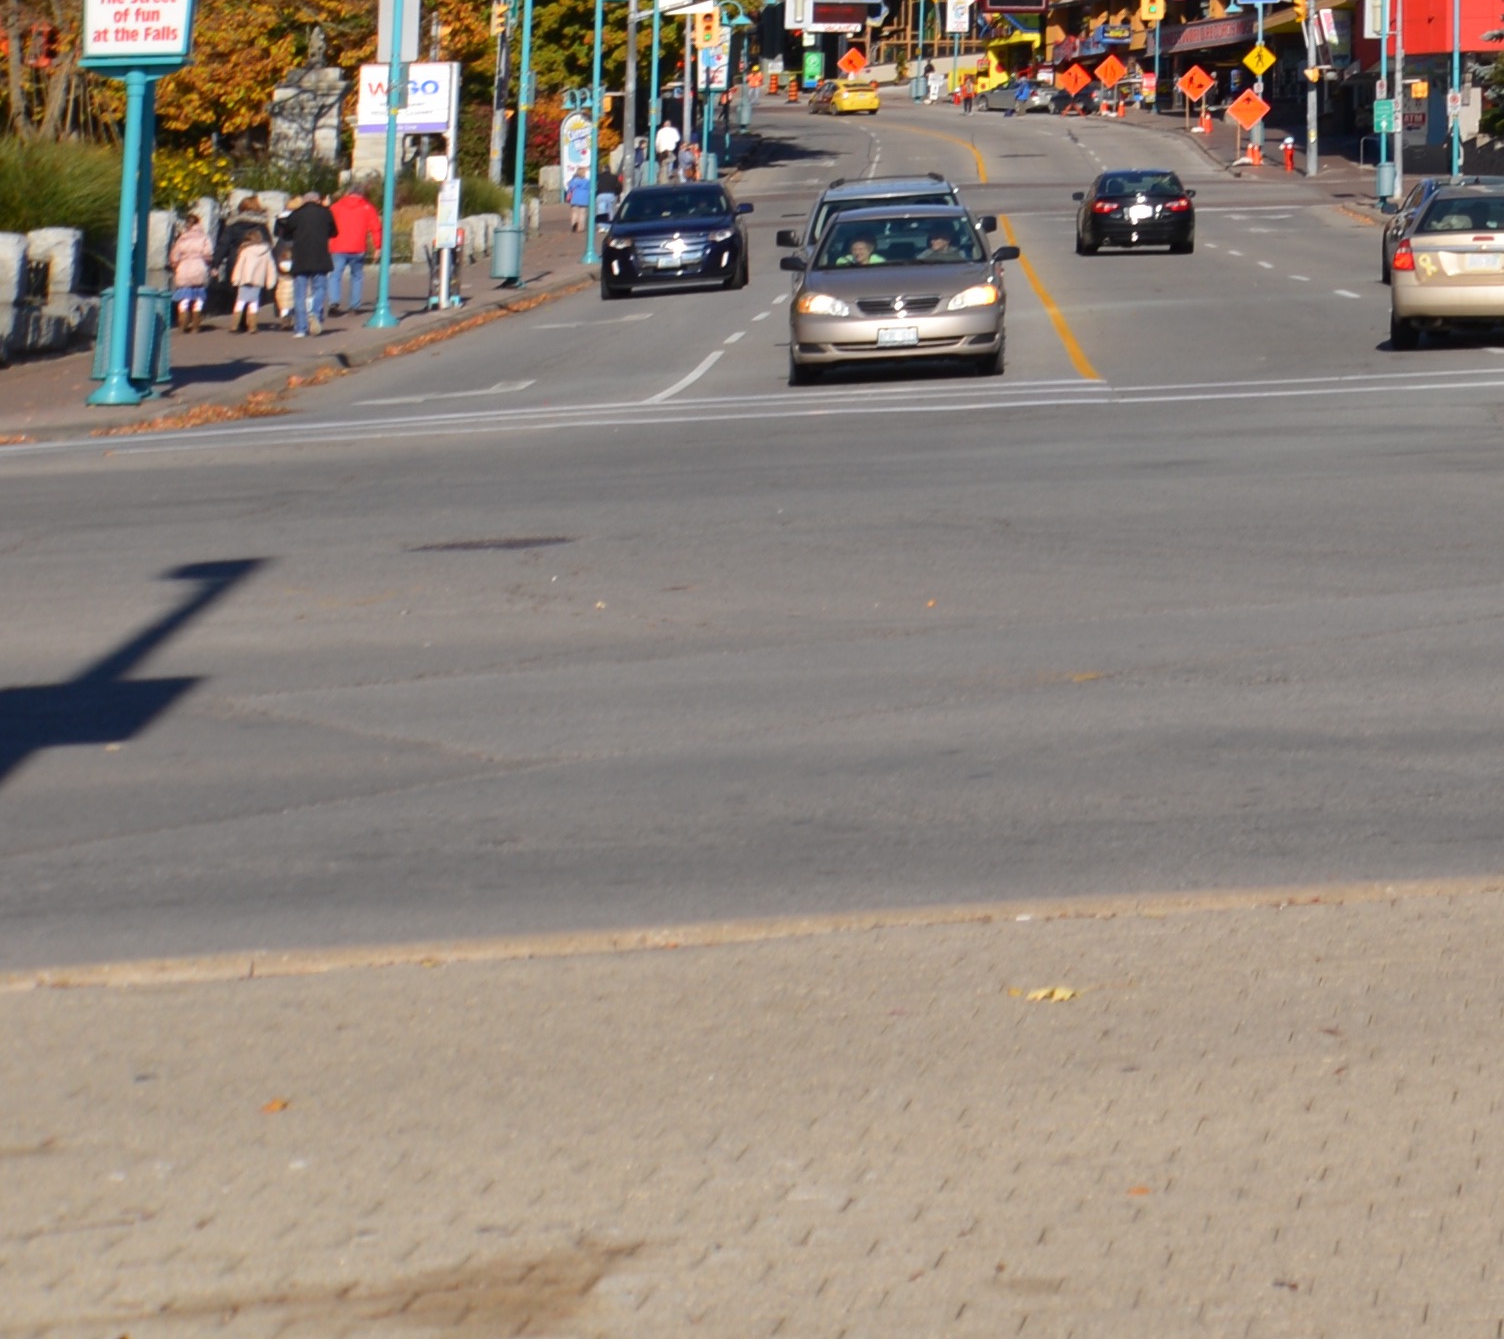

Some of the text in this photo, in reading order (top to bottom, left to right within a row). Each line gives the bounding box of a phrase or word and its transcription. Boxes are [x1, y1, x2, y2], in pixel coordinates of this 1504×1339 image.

[113, 7, 161, 24] of fun
[93, 26, 178, 43] at the Falls
[367, 80, 440, 96] WGO
